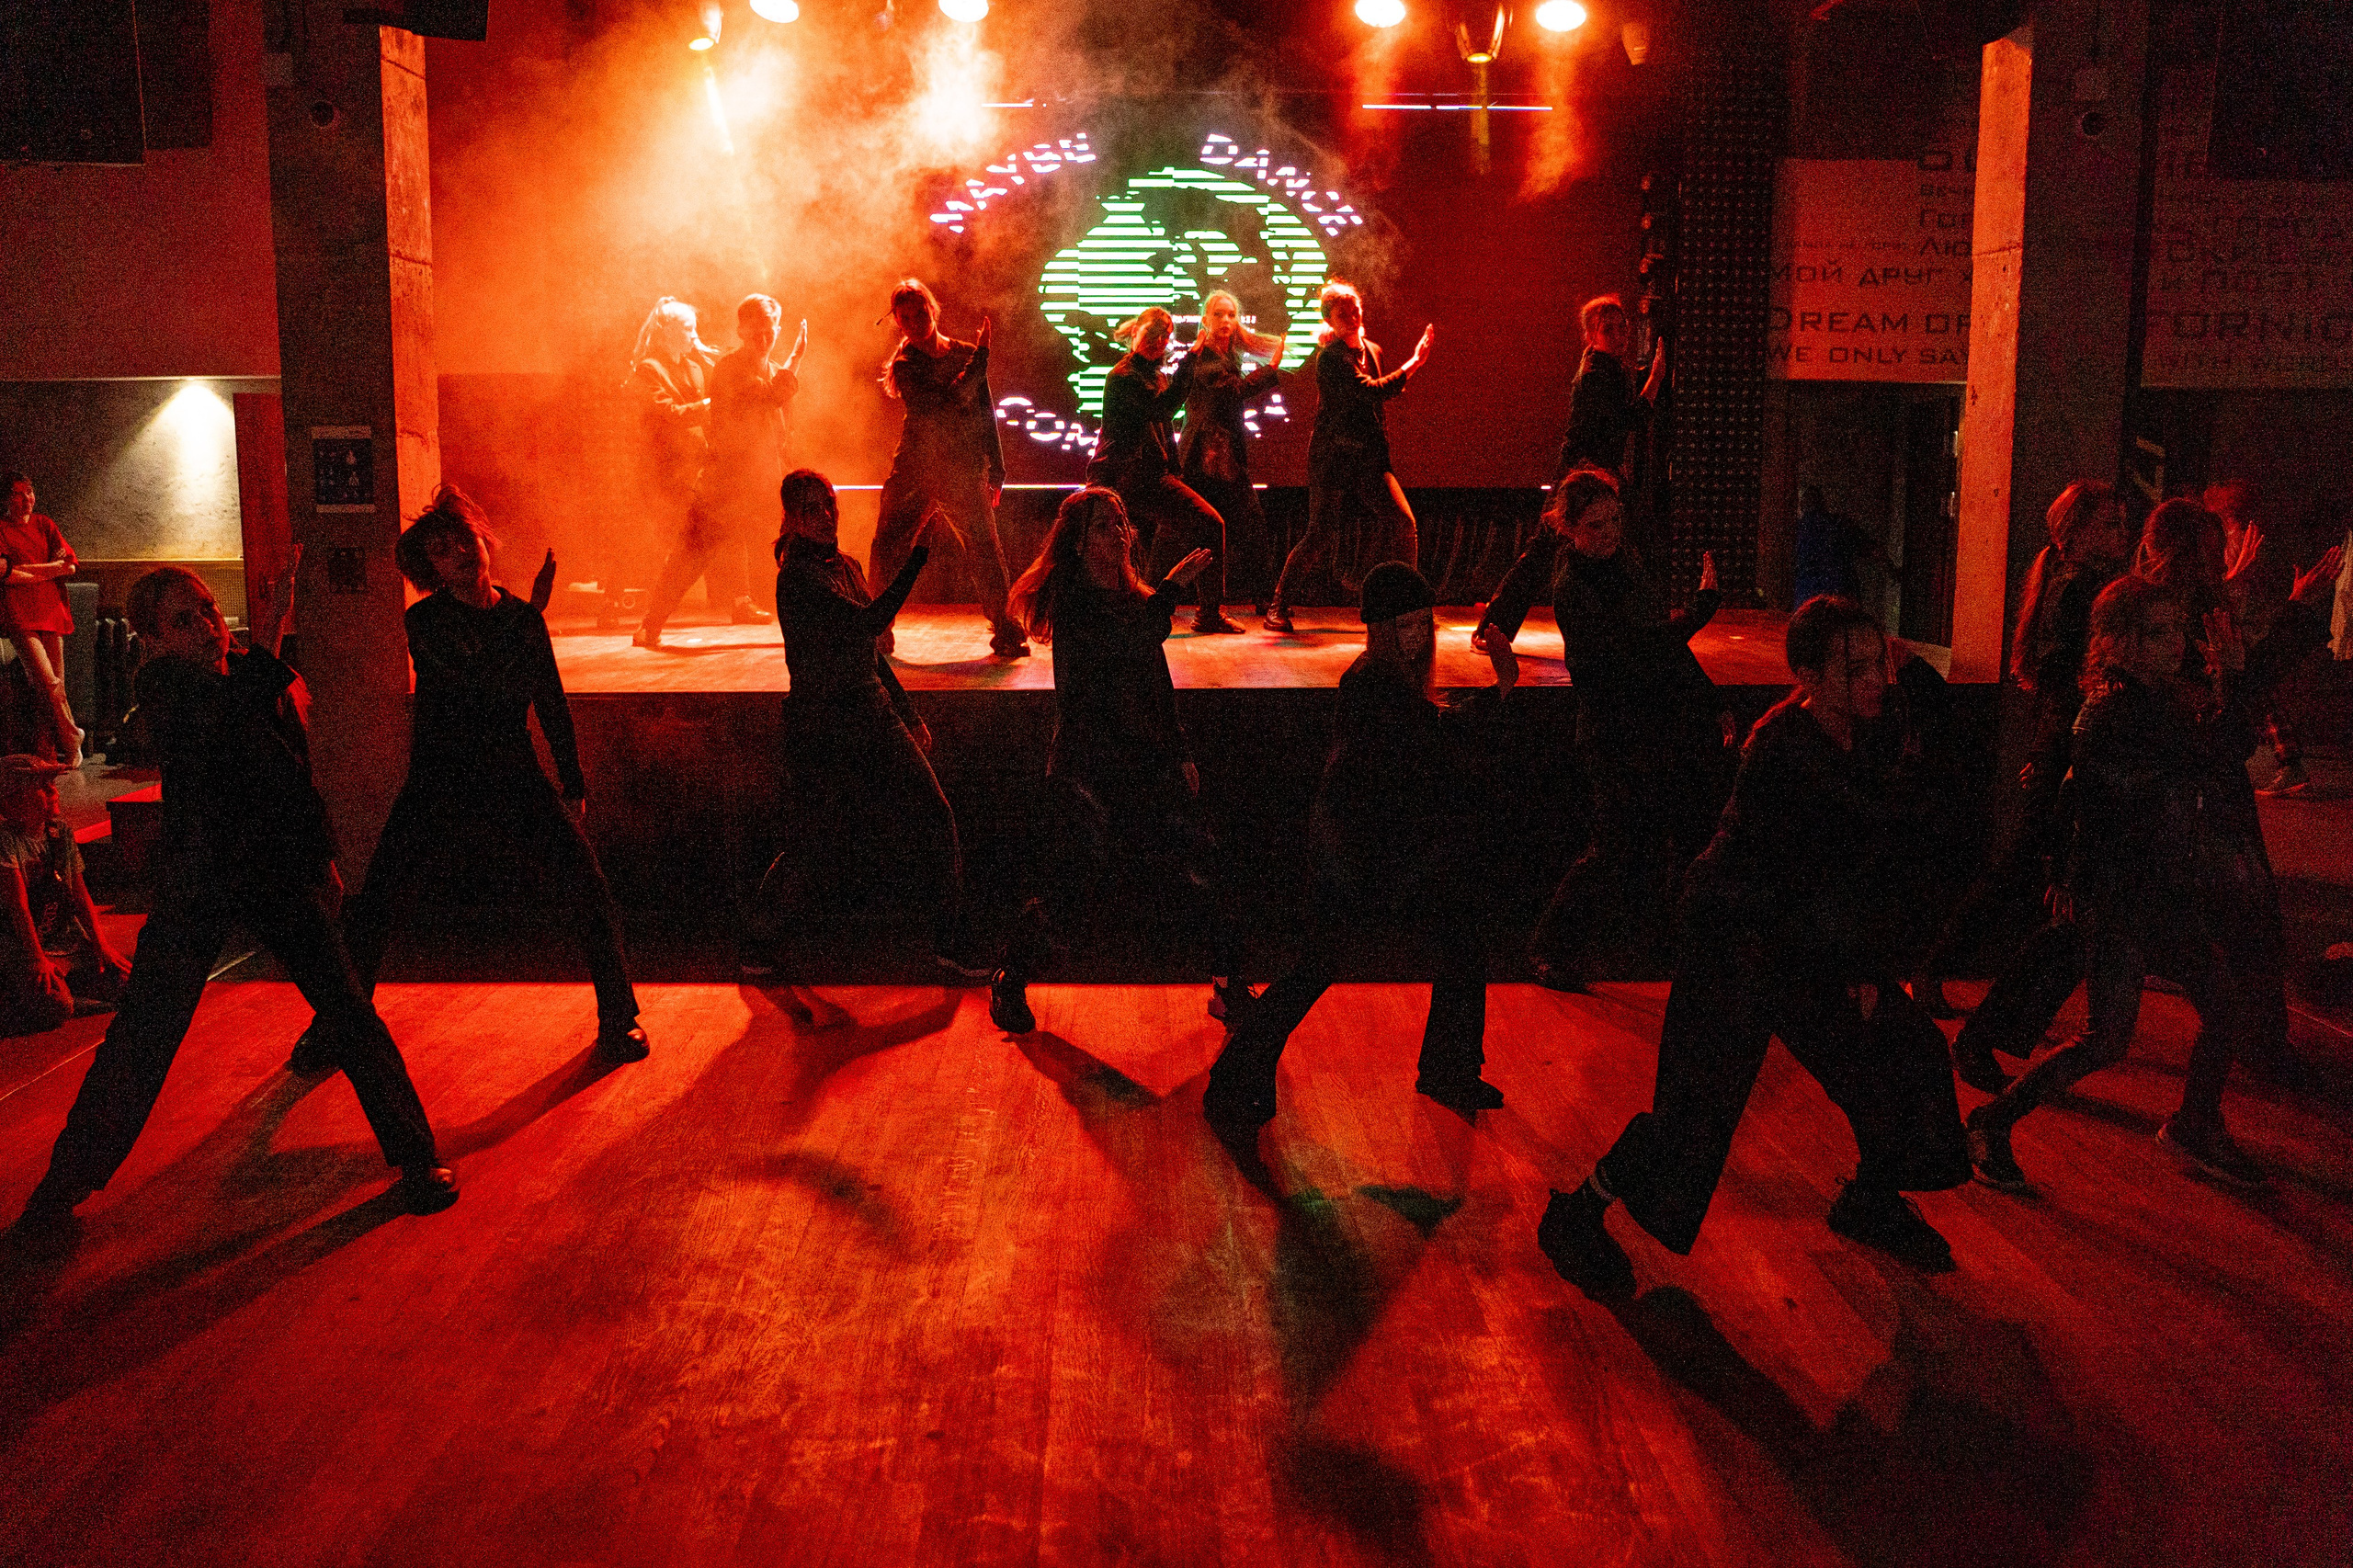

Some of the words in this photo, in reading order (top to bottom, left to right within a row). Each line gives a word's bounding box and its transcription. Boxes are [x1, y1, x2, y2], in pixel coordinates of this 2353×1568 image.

[1199, 133, 1363, 237] DANCE
[1768, 307, 1908, 333] DREAM
[1829, 347, 1906, 364] ONLY
